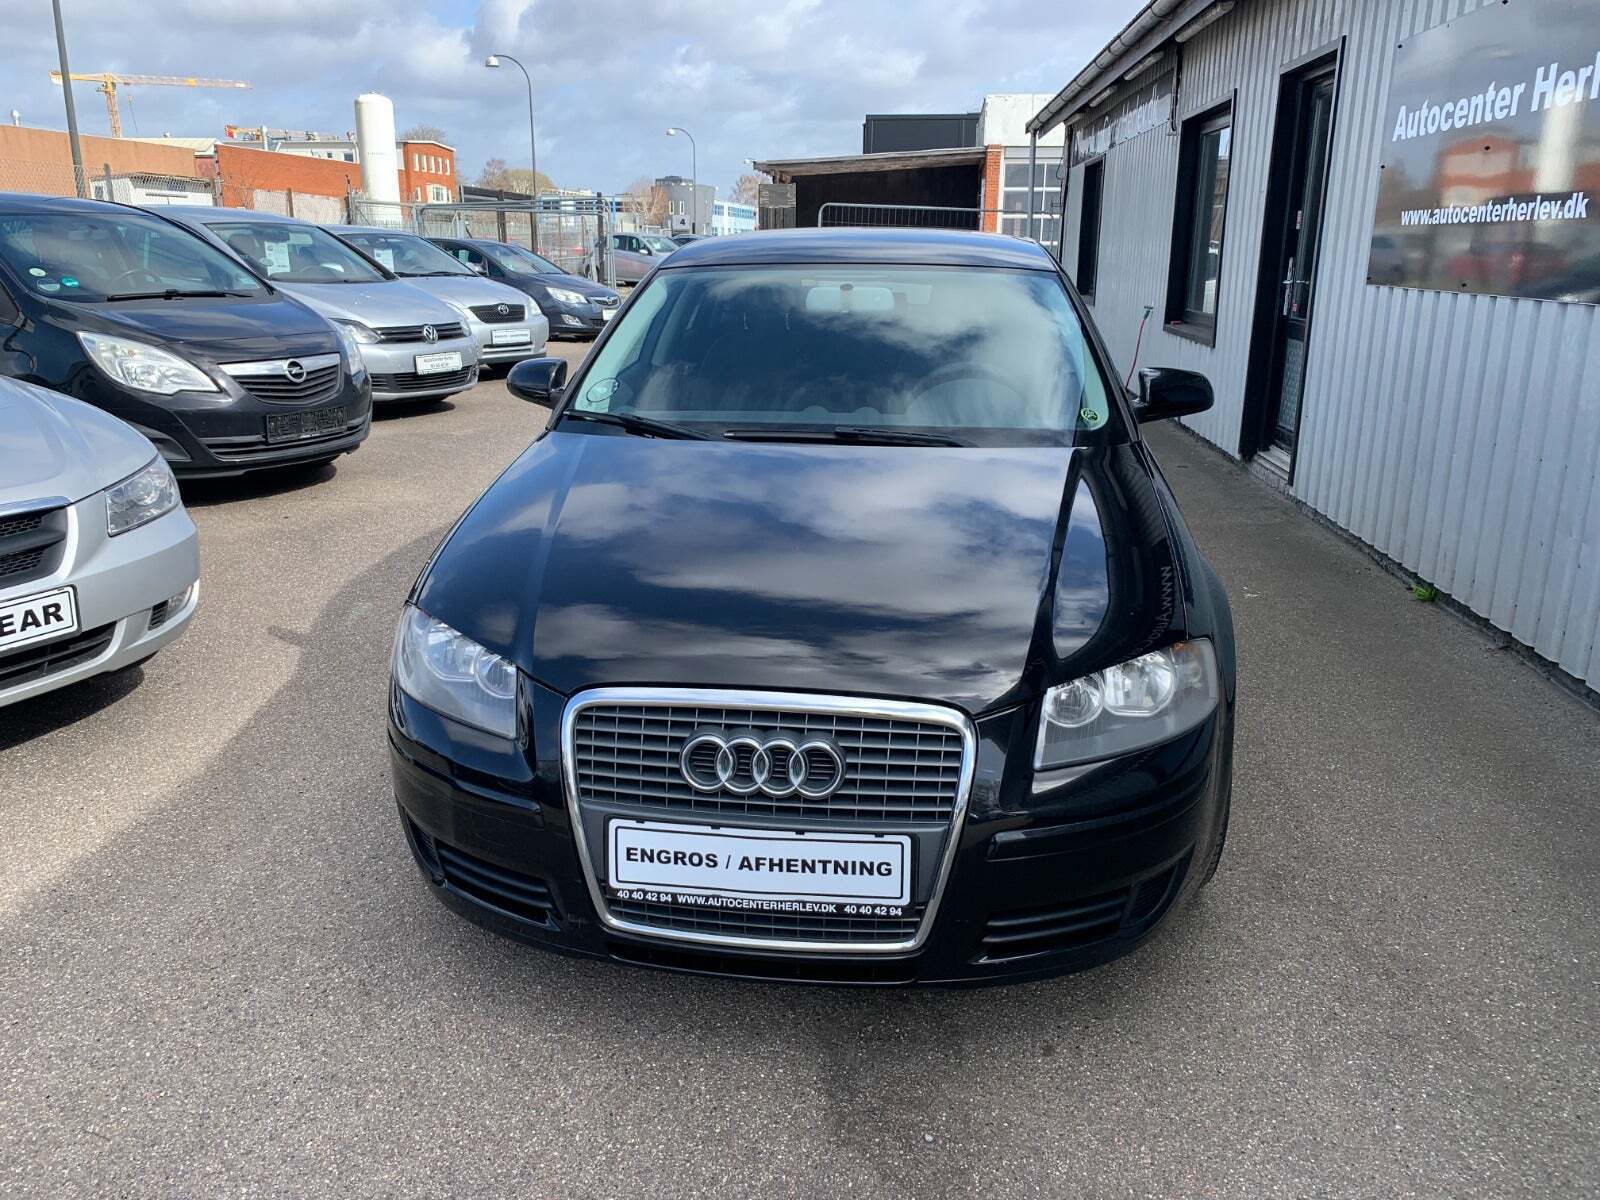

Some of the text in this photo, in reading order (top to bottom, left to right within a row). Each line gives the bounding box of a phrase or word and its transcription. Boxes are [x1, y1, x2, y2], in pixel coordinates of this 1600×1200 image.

[1392, 51, 1600, 142] Autocenter Herl
[1400, 191, 1590, 226] www.autocenterherlev.dk
[625, 847, 893, 877] ENGROS / AFHENTNING
[617, 890, 903, 916] 40 40 42 94 WWW.AUTOCENTERHERLEV.DK 40 40 42 94
